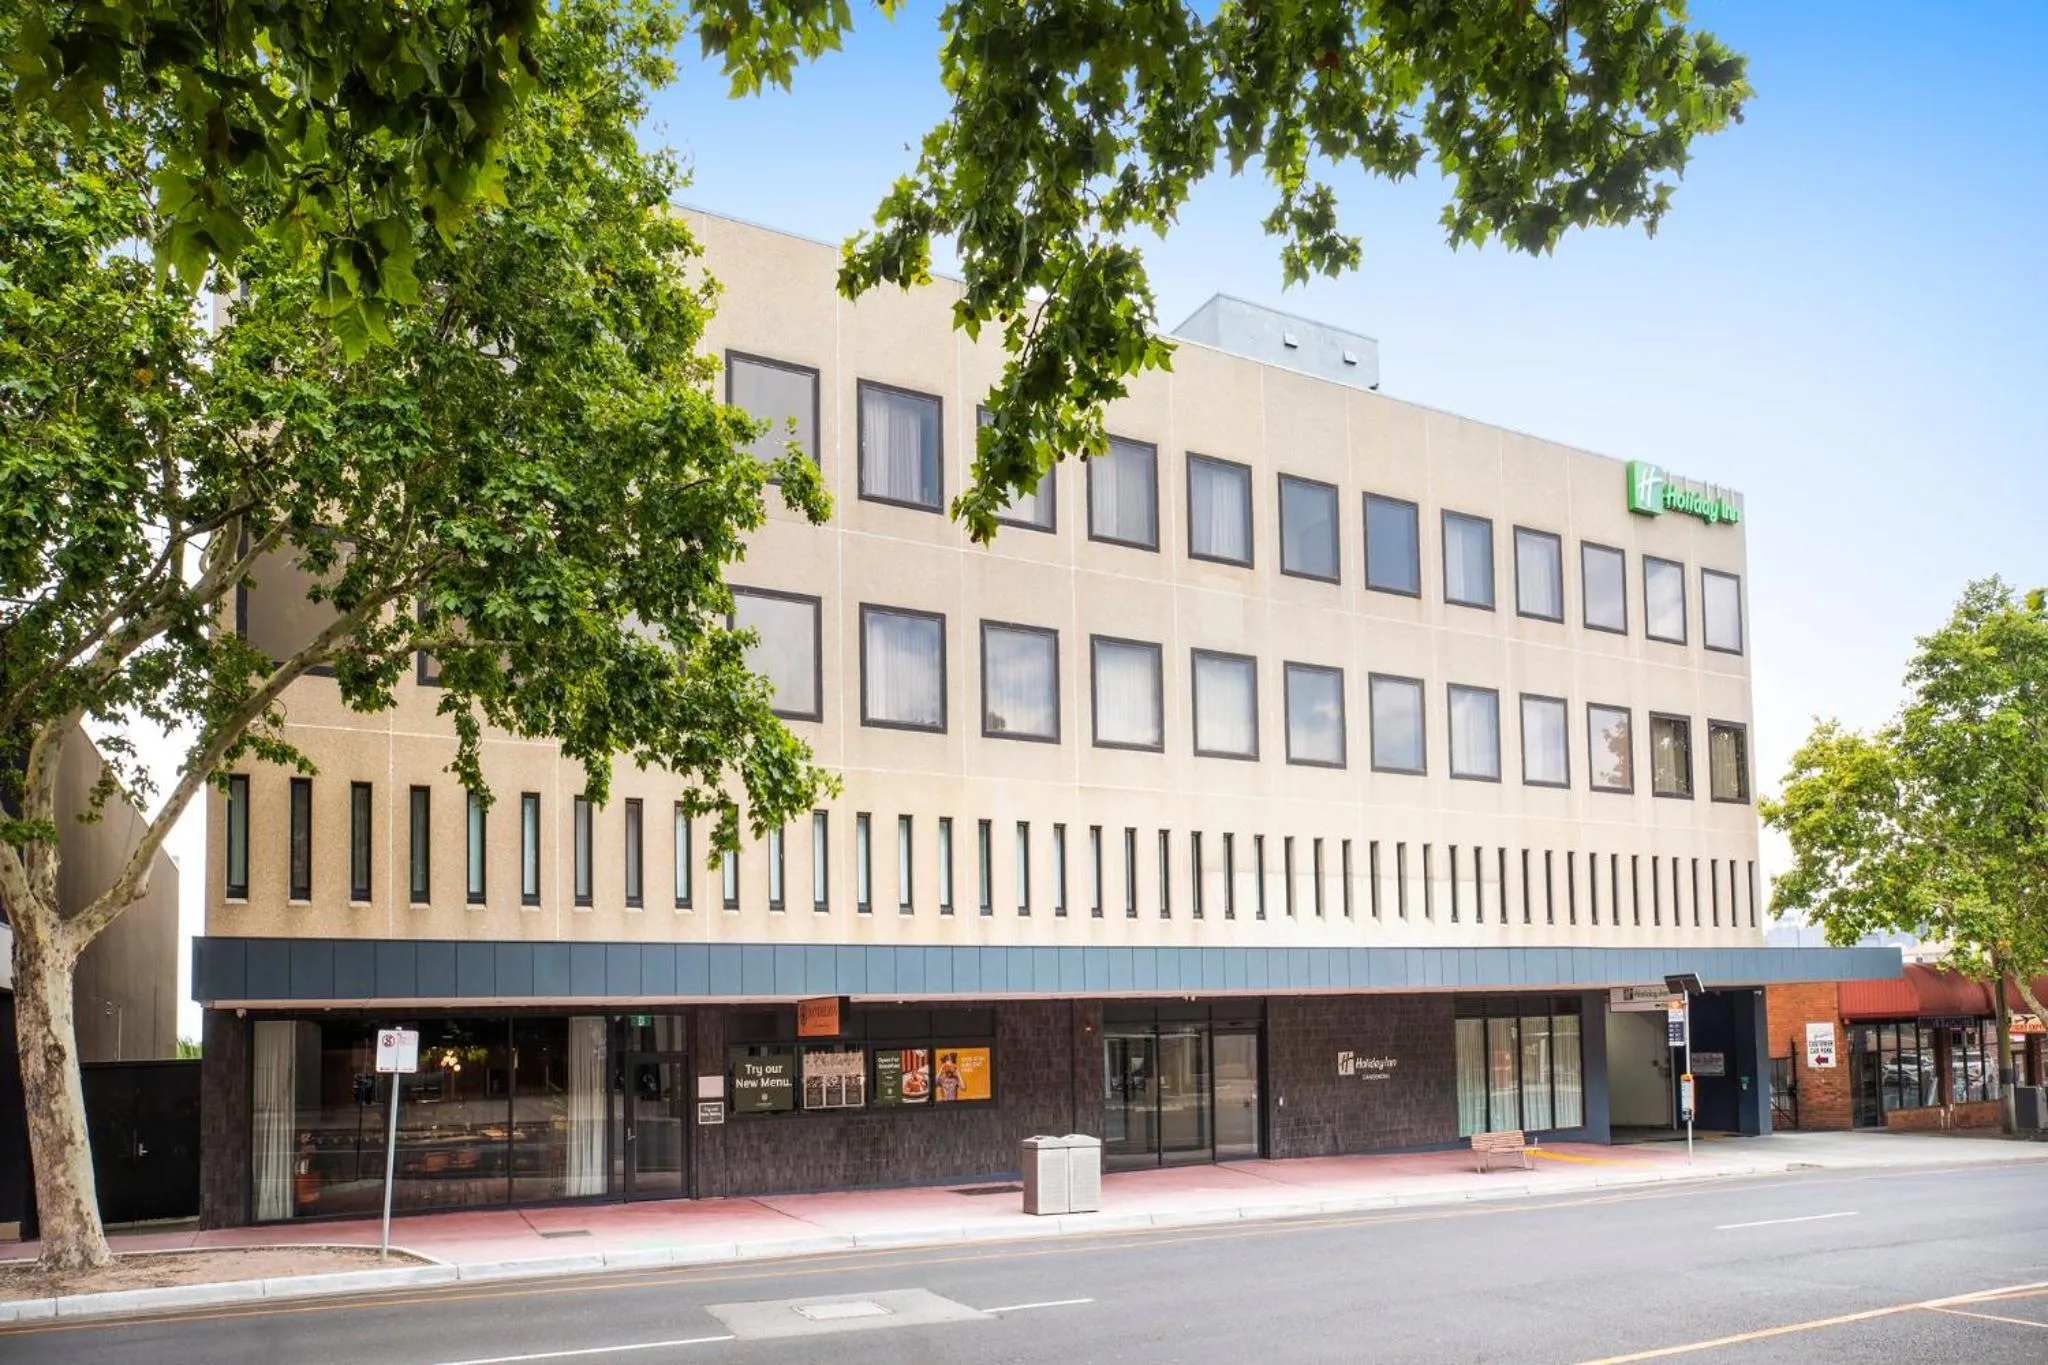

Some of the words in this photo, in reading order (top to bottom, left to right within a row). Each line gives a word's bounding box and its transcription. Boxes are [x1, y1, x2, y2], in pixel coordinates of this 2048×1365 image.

[1665, 483, 1718, 522] Holiday
[1721, 497, 1738, 521] Inn
[745, 1064, 762, 1076] Try
[766, 1065, 783, 1074] our
[1355, 1057, 1384, 1071] Holiday
[1384, 1056, 1397, 1067] Inn
[736, 1078, 758, 1088] New
[761, 1077, 793, 1087] Menu.
